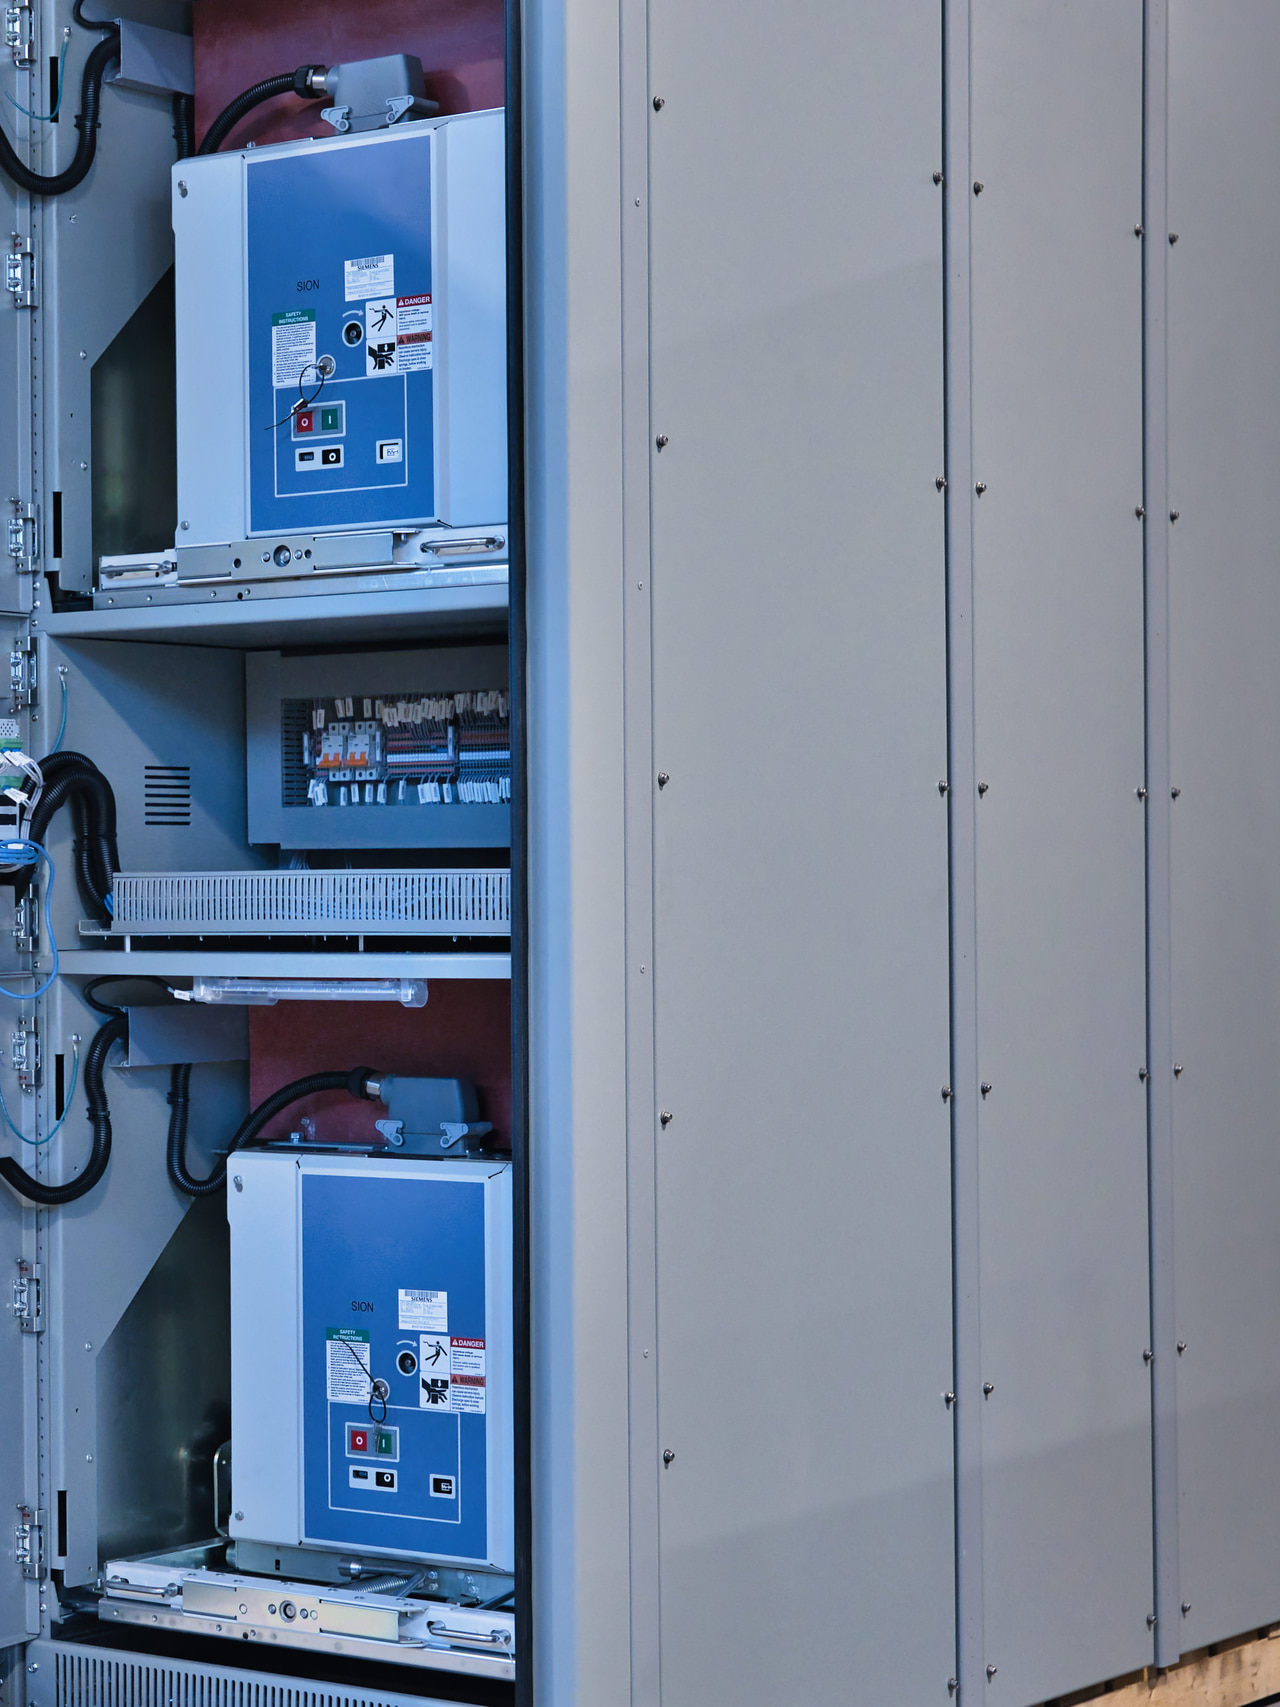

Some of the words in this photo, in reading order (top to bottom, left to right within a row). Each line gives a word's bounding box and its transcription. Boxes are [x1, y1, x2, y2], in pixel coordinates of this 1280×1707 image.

[297, 280, 320, 291] SION
[405, 296, 430, 305] DANGER
[406, 333, 431, 343] WARNING
[351, 1301, 374, 1312] SION
[458, 1340, 484, 1348] DANGER
[459, 1376, 484, 1386] WARNING
